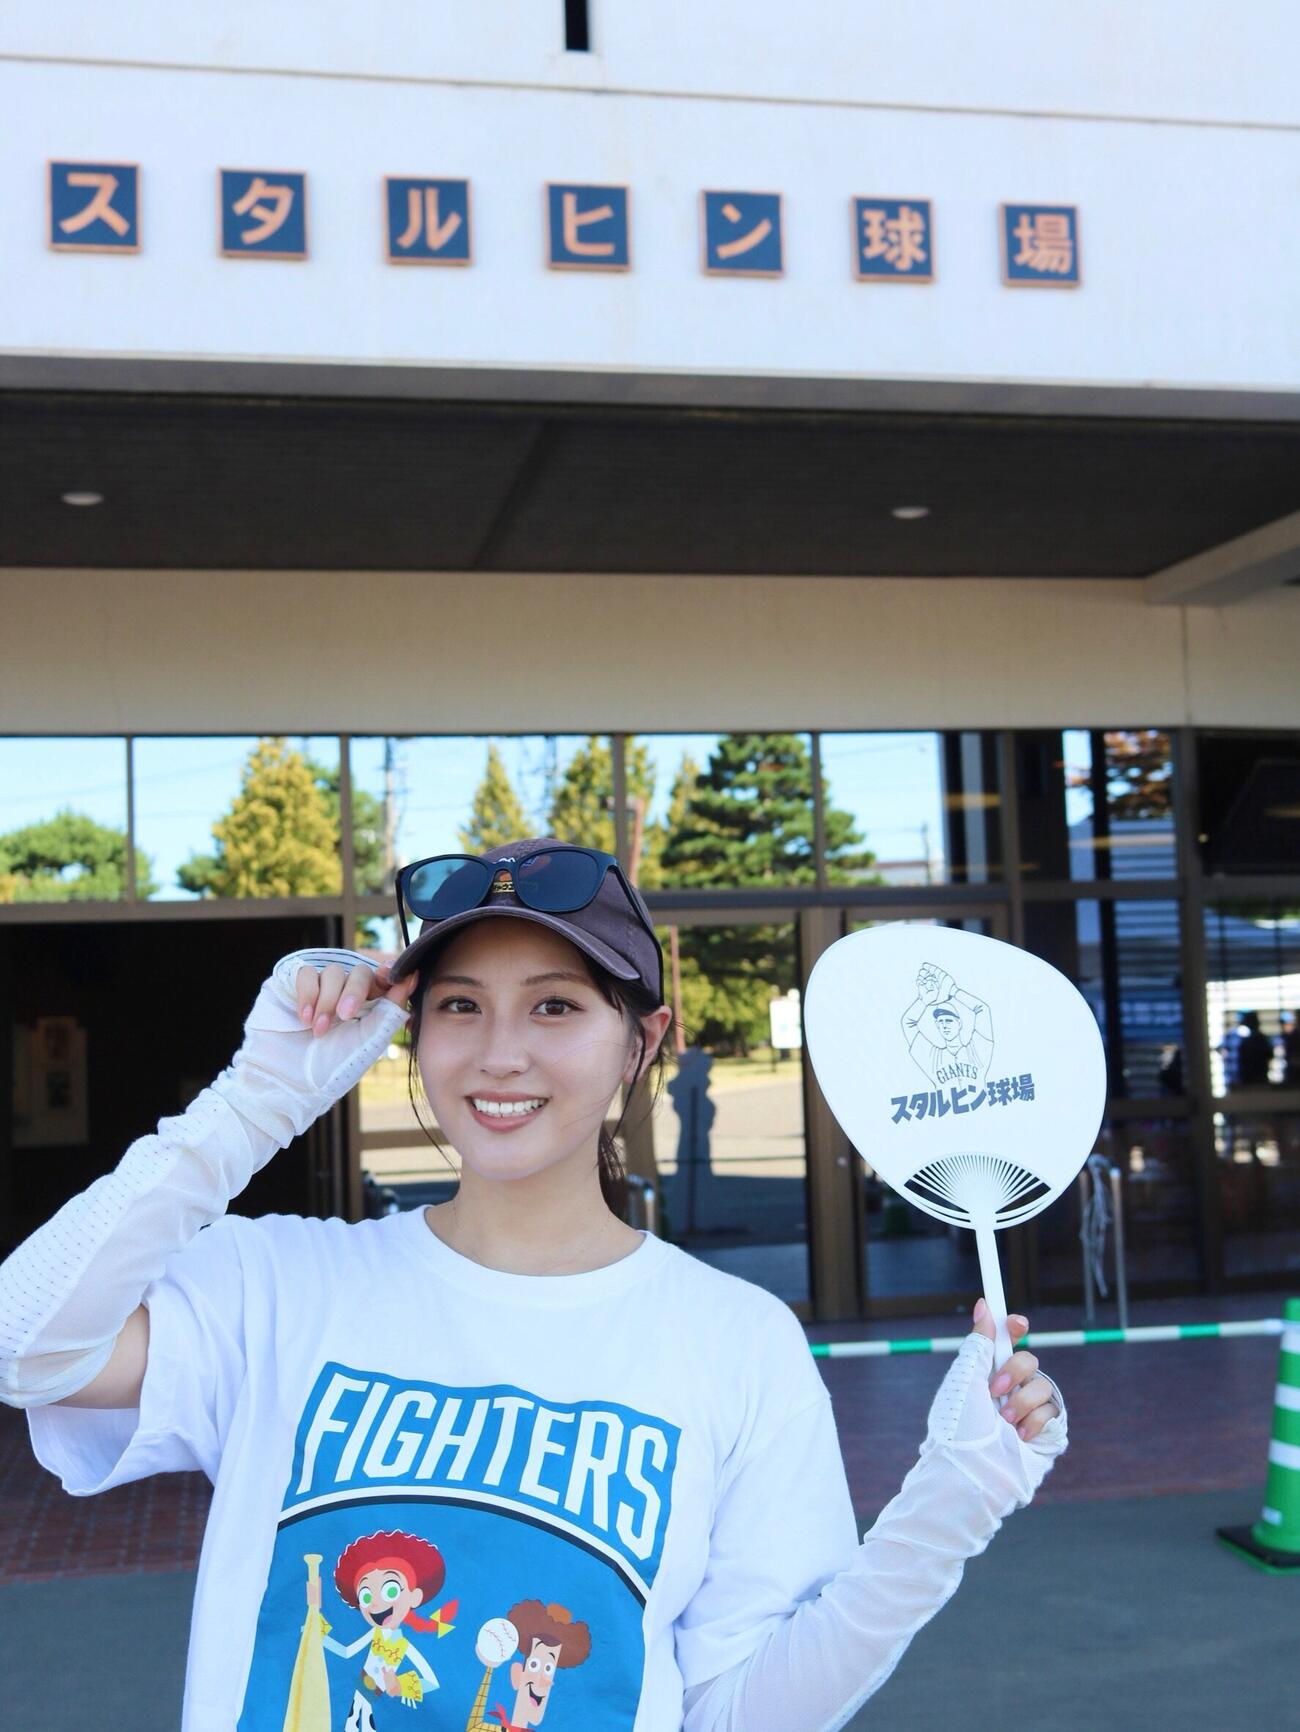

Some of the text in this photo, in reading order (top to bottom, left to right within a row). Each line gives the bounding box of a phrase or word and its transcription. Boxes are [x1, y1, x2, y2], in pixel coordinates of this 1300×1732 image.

[60, 171, 1073, 275] スタルヒン球場
[890, 1073, 1035, 1125] スタルヒン球場
[936, 1062, 978, 1085] GIANTS
[296, 1372, 668, 1561] FIGHTERS
